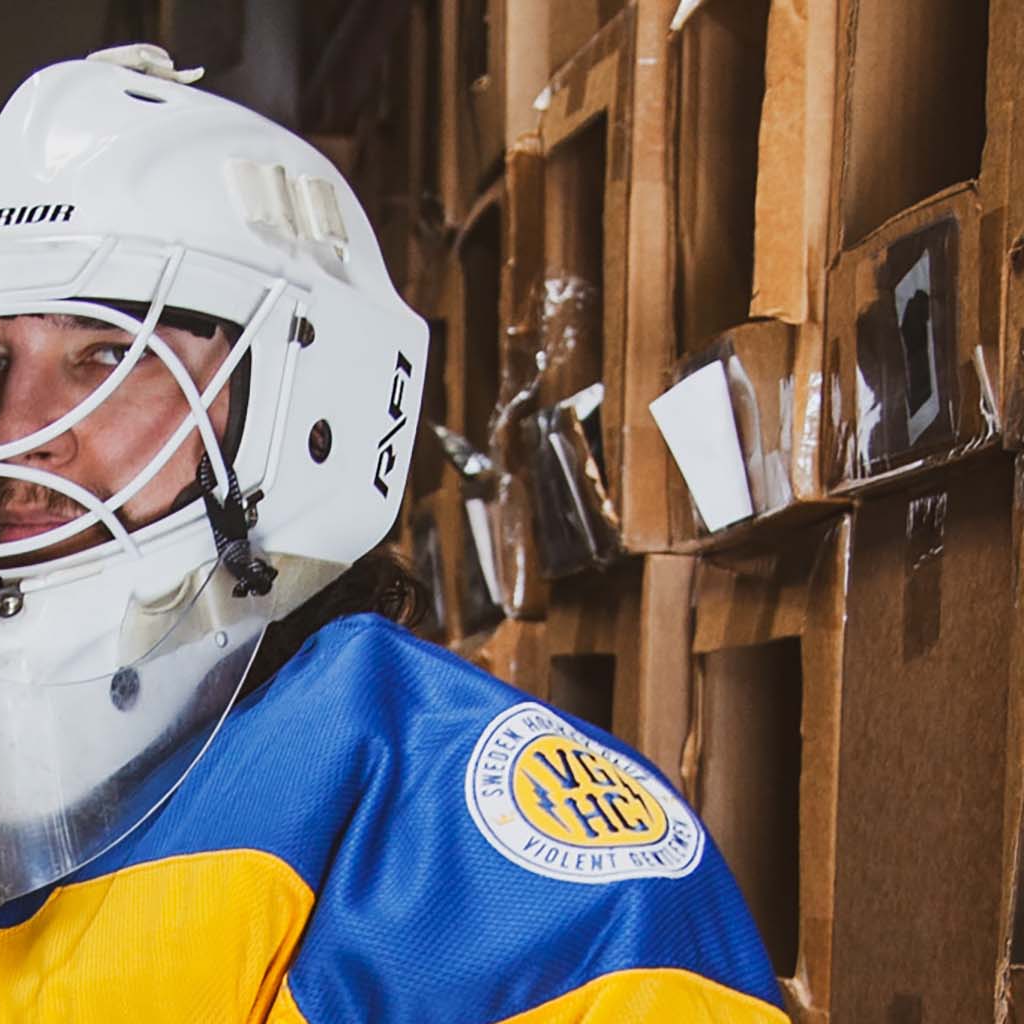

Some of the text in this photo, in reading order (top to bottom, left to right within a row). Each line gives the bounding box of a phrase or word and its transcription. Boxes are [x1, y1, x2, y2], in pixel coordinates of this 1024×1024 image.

[482, 728, 523, 798] SWEDEN
[533, 748, 616, 789] VG
[565, 791, 649, 838] HC
[523, 835, 617, 871] VIOLENT
